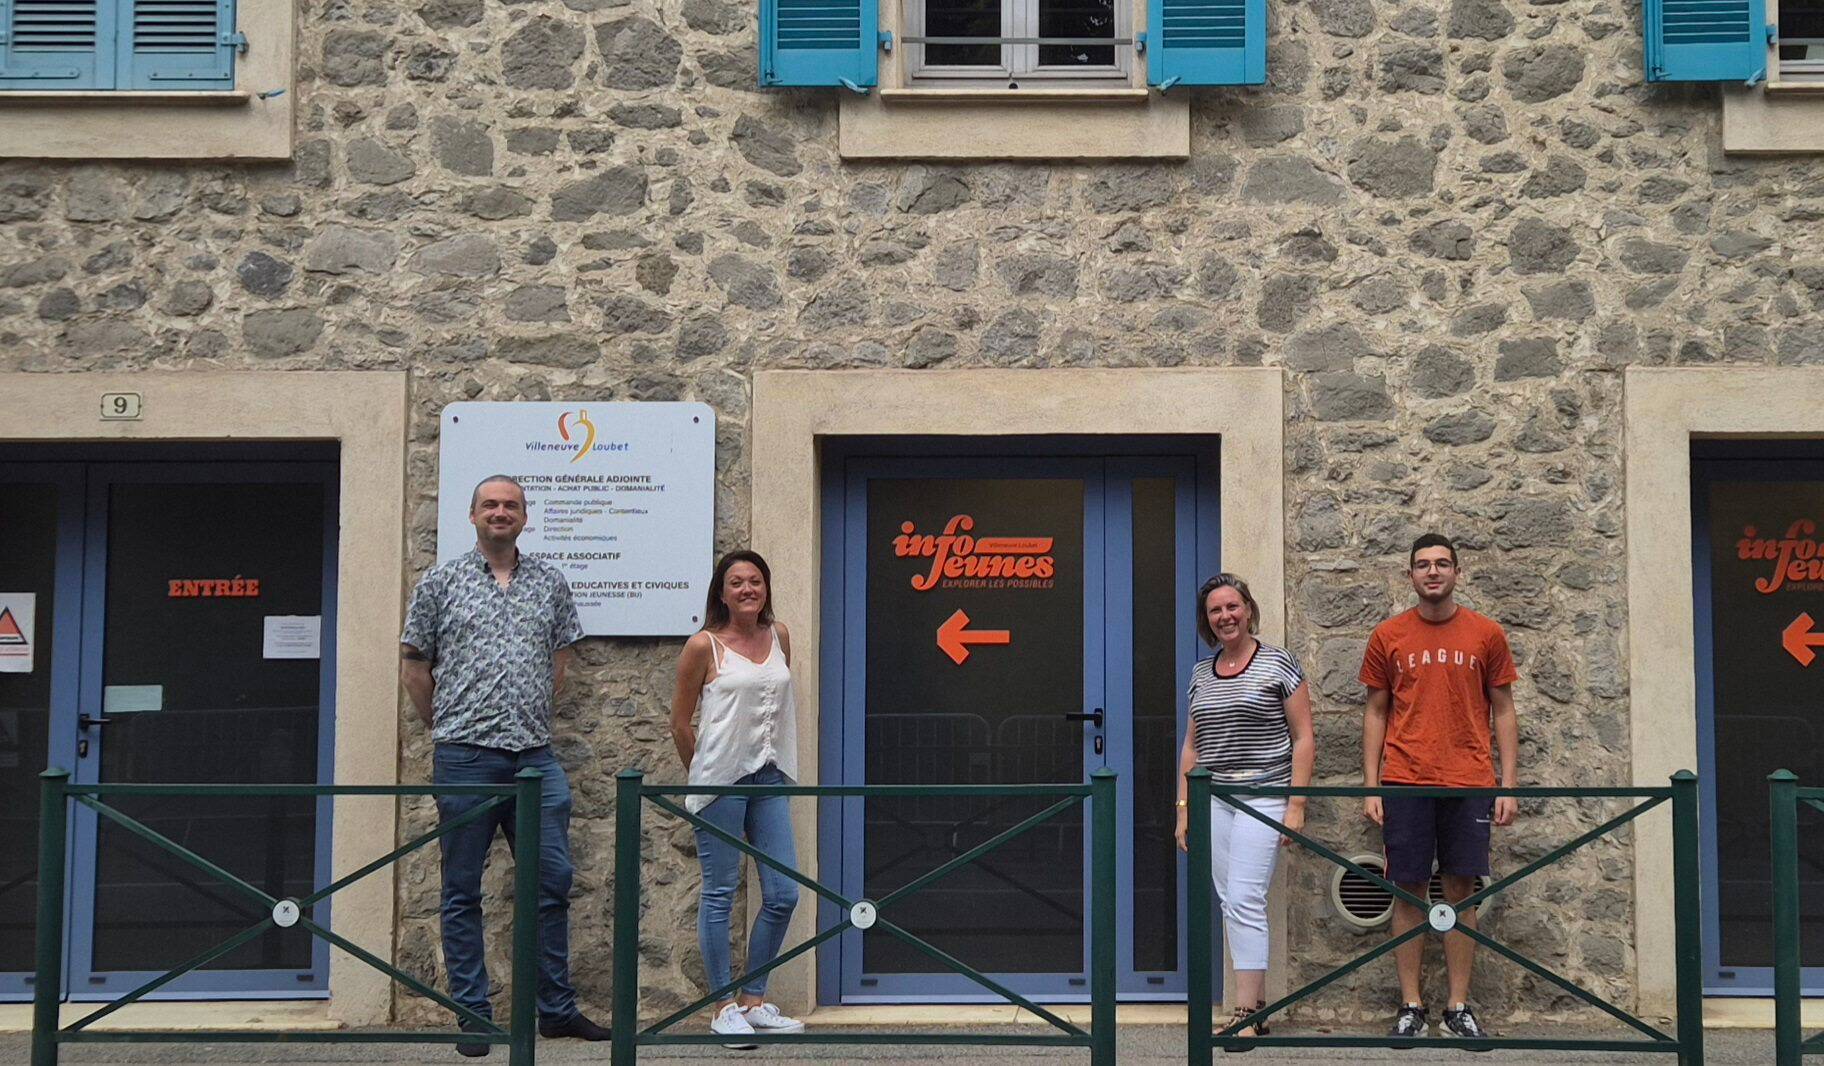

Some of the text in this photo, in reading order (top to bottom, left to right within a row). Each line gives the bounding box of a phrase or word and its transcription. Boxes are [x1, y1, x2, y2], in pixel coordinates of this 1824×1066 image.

[114, 396, 127, 414] 9
[525, 442, 629, 451] Villeneuve Loubet
[555, 474, 604, 483] GÉNÉRALE
[606, 475, 652, 483] ADJOINTE
[615, 484, 666, 492] DOMANIALITÉ
[584, 499, 613, 507] publique
[566, 552, 622, 561] ASSOCIATIF
[569, 562, 588, 571] étage
[168, 574, 260, 597] ENTRÉE
[571, 581, 690, 591] EDUCATIVES ET CIVIQUES
[942, 579, 1054, 589] EXPLORER LES POSSIBLES
[589, 591, 625, 599] JEUNESSE
[1396, 648, 1477, 673] LEAGUE
